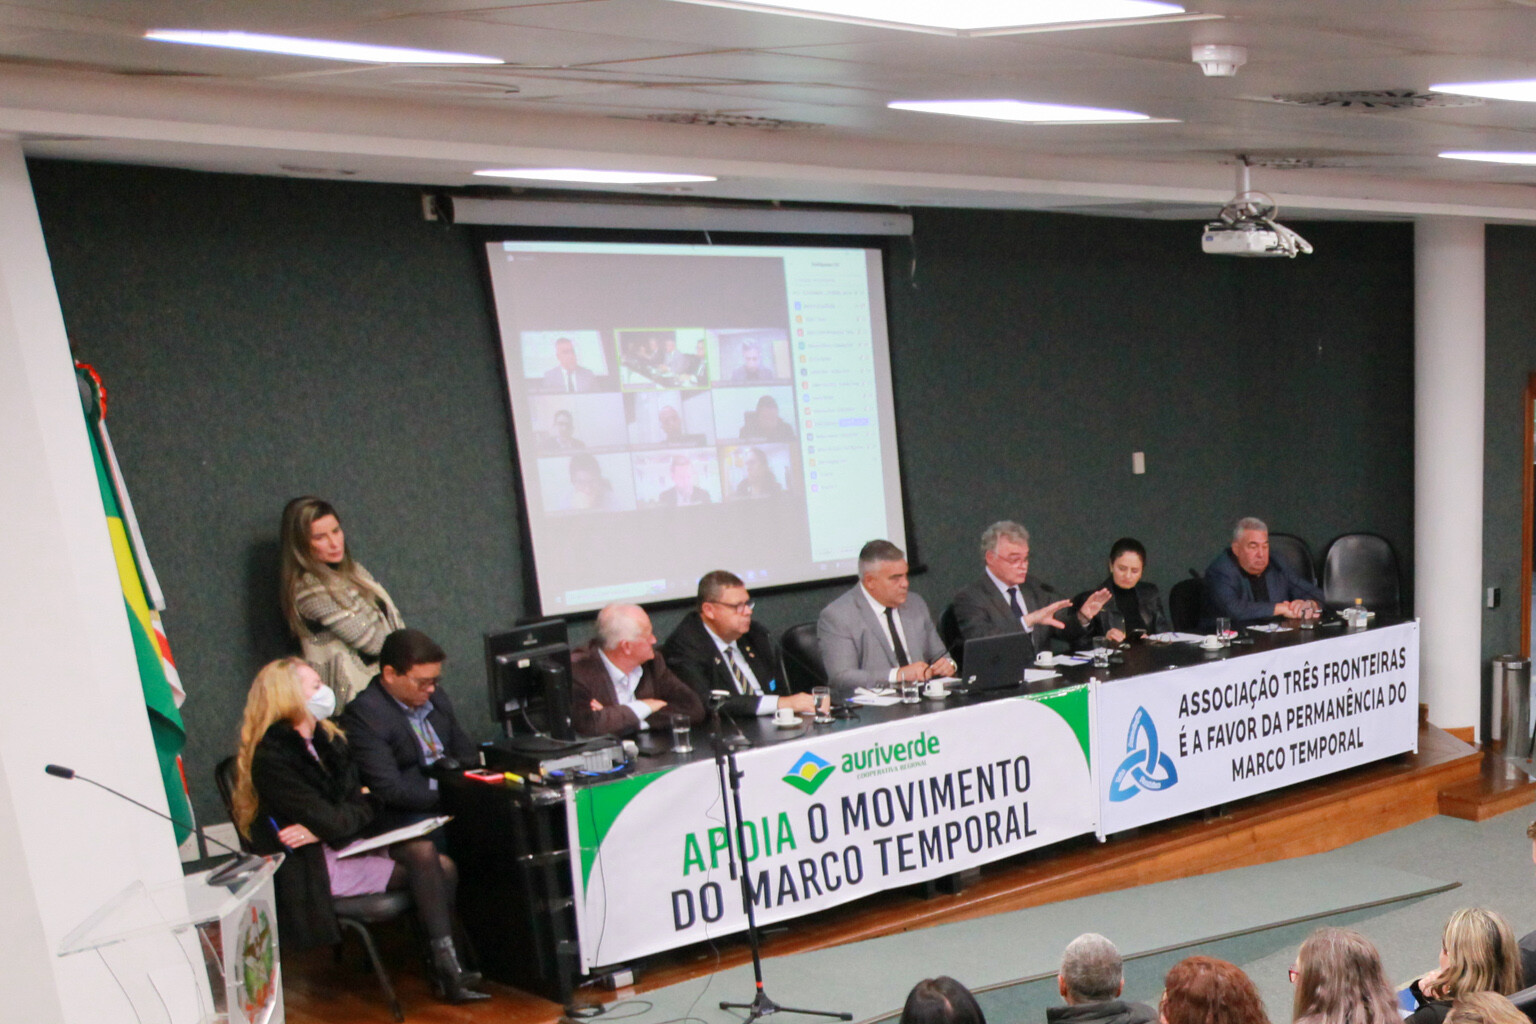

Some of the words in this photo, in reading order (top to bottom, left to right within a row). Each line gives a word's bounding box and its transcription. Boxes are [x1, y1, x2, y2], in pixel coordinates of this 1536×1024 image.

[1178, 670, 1279, 718] ASSOCIAÇÃO
[1284, 661, 1319, 695] TRÊS
[1323, 647, 1406, 686] FRONTEIRAS
[1179, 725, 1188, 757] É
[1193, 729, 1203, 754] A
[1207, 716, 1257, 750] FAVOR
[1262, 711, 1282, 738] DA
[1286, 685, 1385, 732] PERMANÊNCIA
[1389, 681, 1407, 706] DO
[841, 731, 940, 773] auriverde
[1232, 747, 1285, 782] MARCO
[1289, 726, 1363, 766] TEMPORAL
[683, 812, 797, 876] APOIA
[808, 803, 829, 843] O
[841, 755, 1031, 835] MOVIMENTO
[671, 881, 724, 931] DO
[740, 845, 864, 914] MARCO
[873, 801, 1037, 876] TEMPORAL
